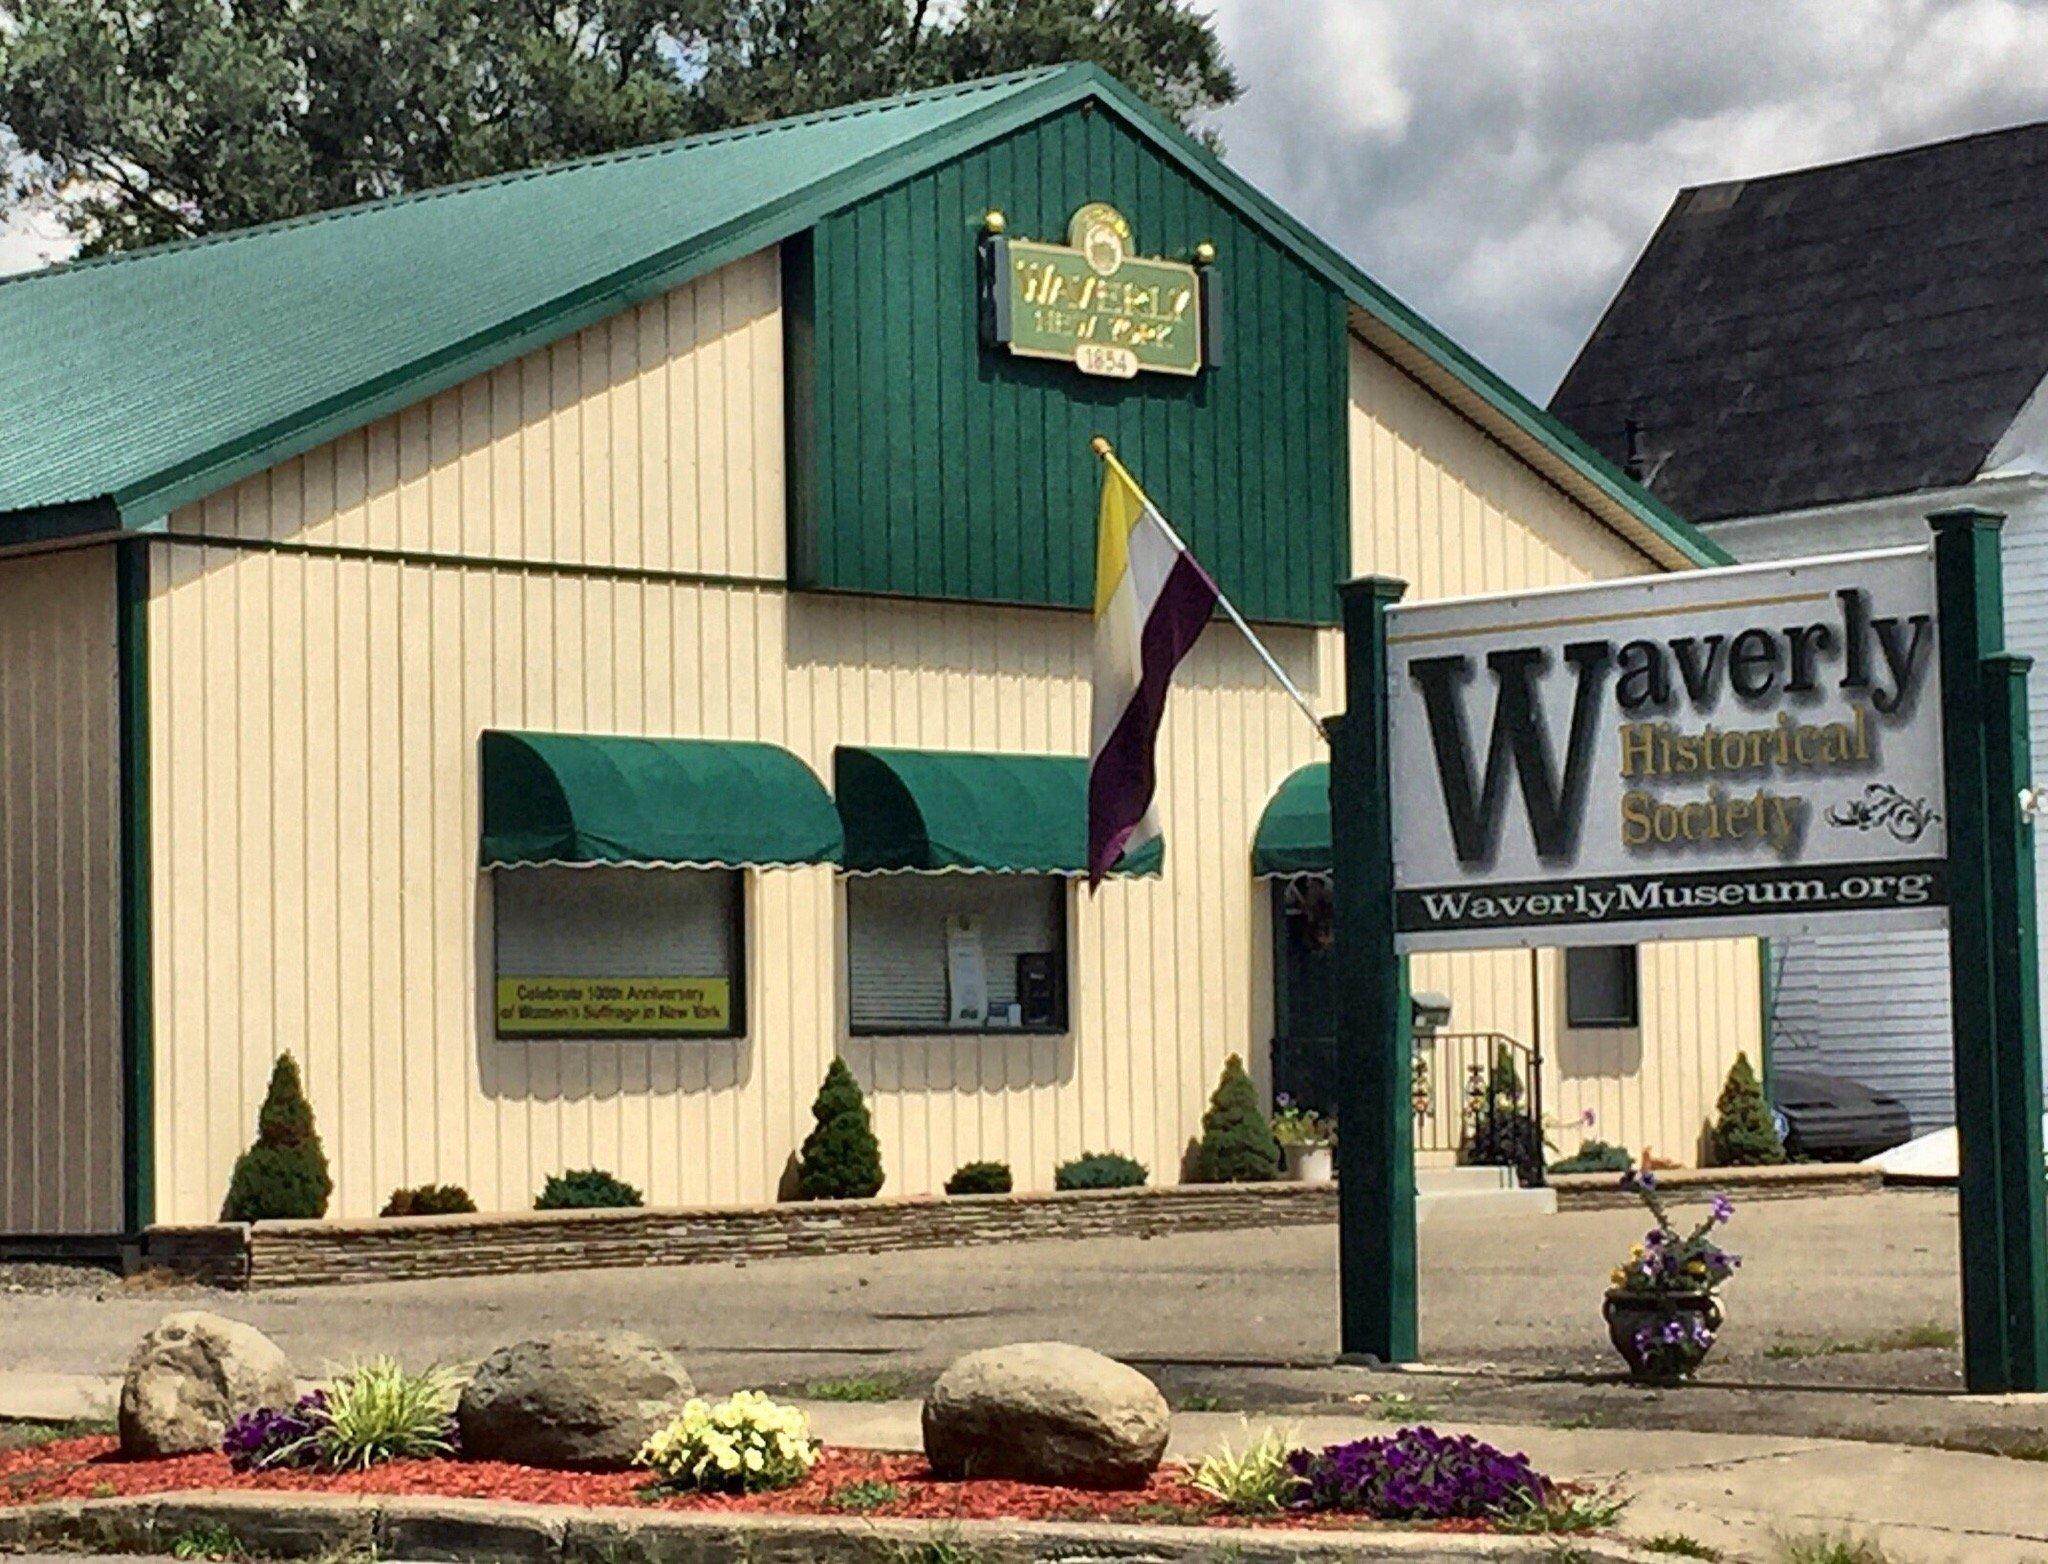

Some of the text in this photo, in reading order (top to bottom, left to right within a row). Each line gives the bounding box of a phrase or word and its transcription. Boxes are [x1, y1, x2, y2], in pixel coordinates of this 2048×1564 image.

[1408, 588, 1930, 863] Waverly
[1619, 703, 1870, 777] Historical
[1620, 783, 1803, 851] Society
[1422, 871, 1934, 921] WaverlyMuseum.org
[500, 1004, 515, 1019] of
[659, 1004, 689, 1020] New
[692, 1004, 722, 1020] York
[516, 984, 583, 1001] Celebrate
[627, 985, 704, 1003] Anniversary
